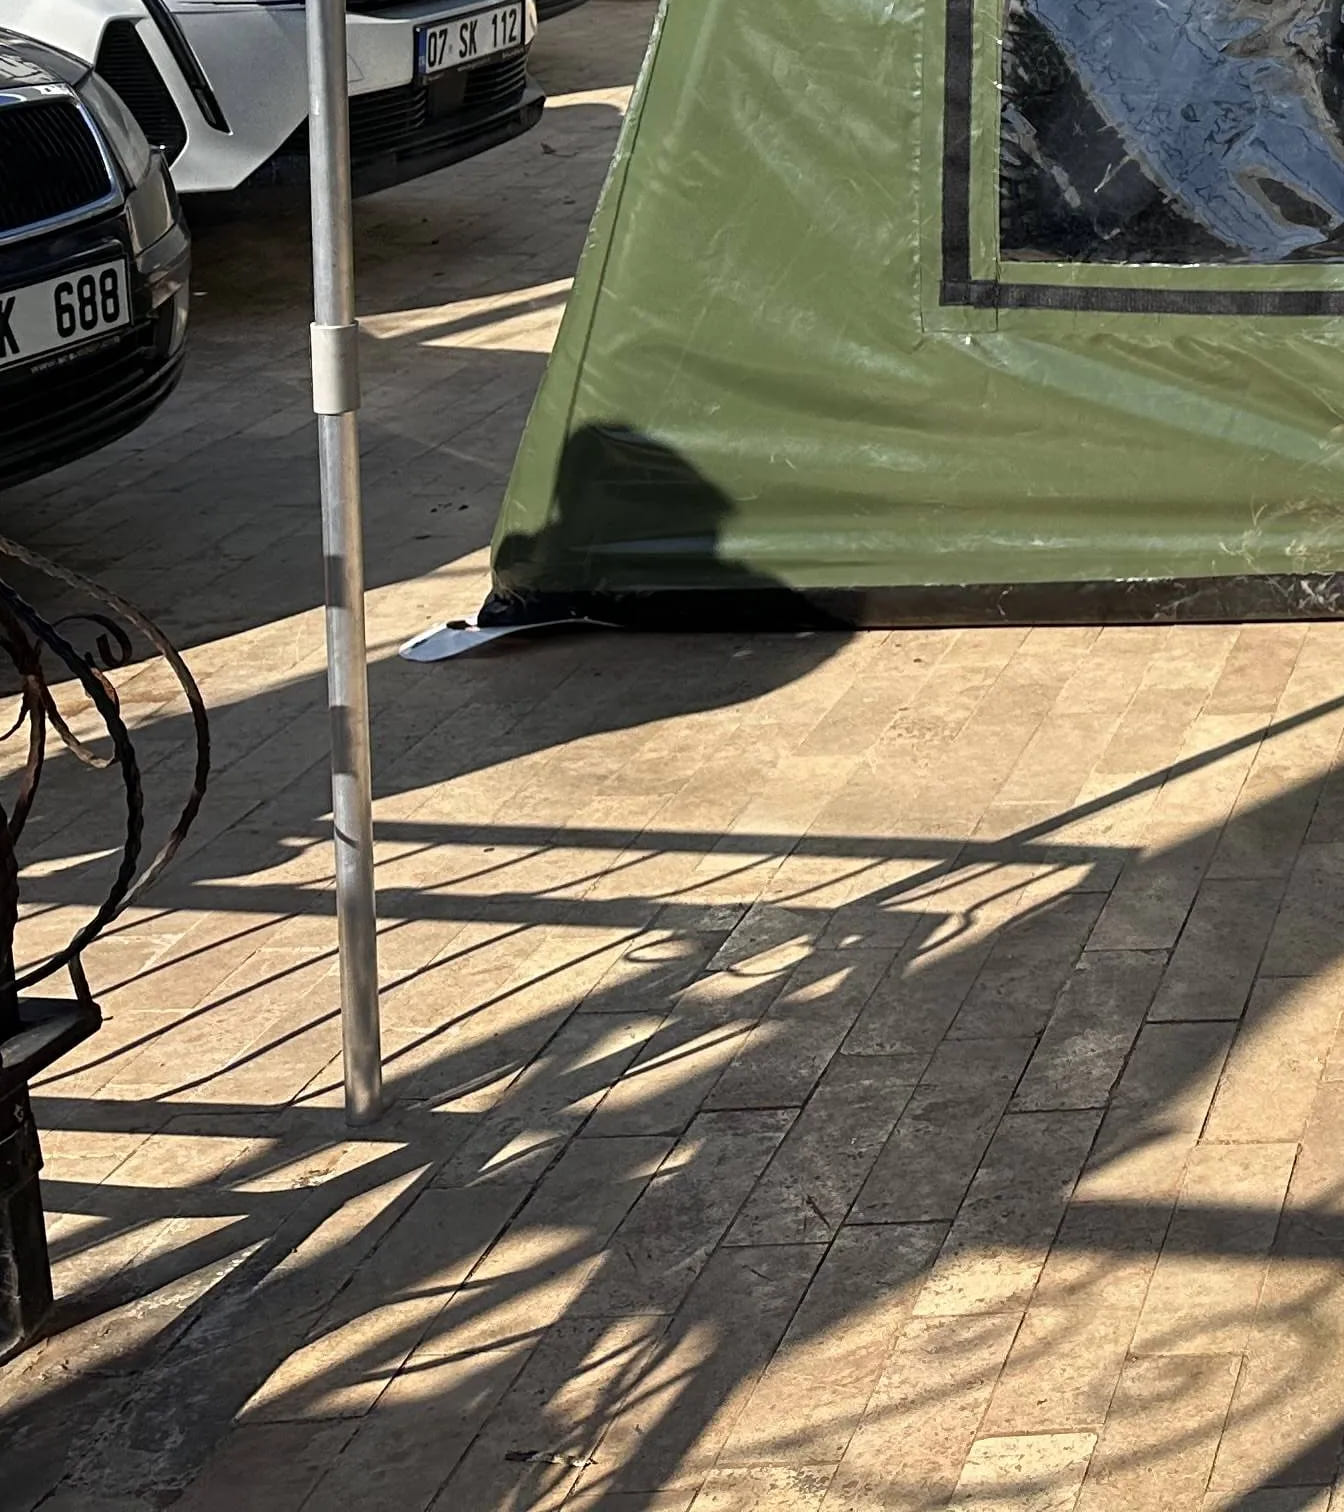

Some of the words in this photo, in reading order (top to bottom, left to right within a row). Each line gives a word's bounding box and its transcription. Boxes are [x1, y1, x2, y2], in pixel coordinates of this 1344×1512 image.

[428, 28, 448, 68] 07
[459, 19, 478, 58] SK
[491, 8, 518, 48] 112
[54, 268, 120, 338] 688
